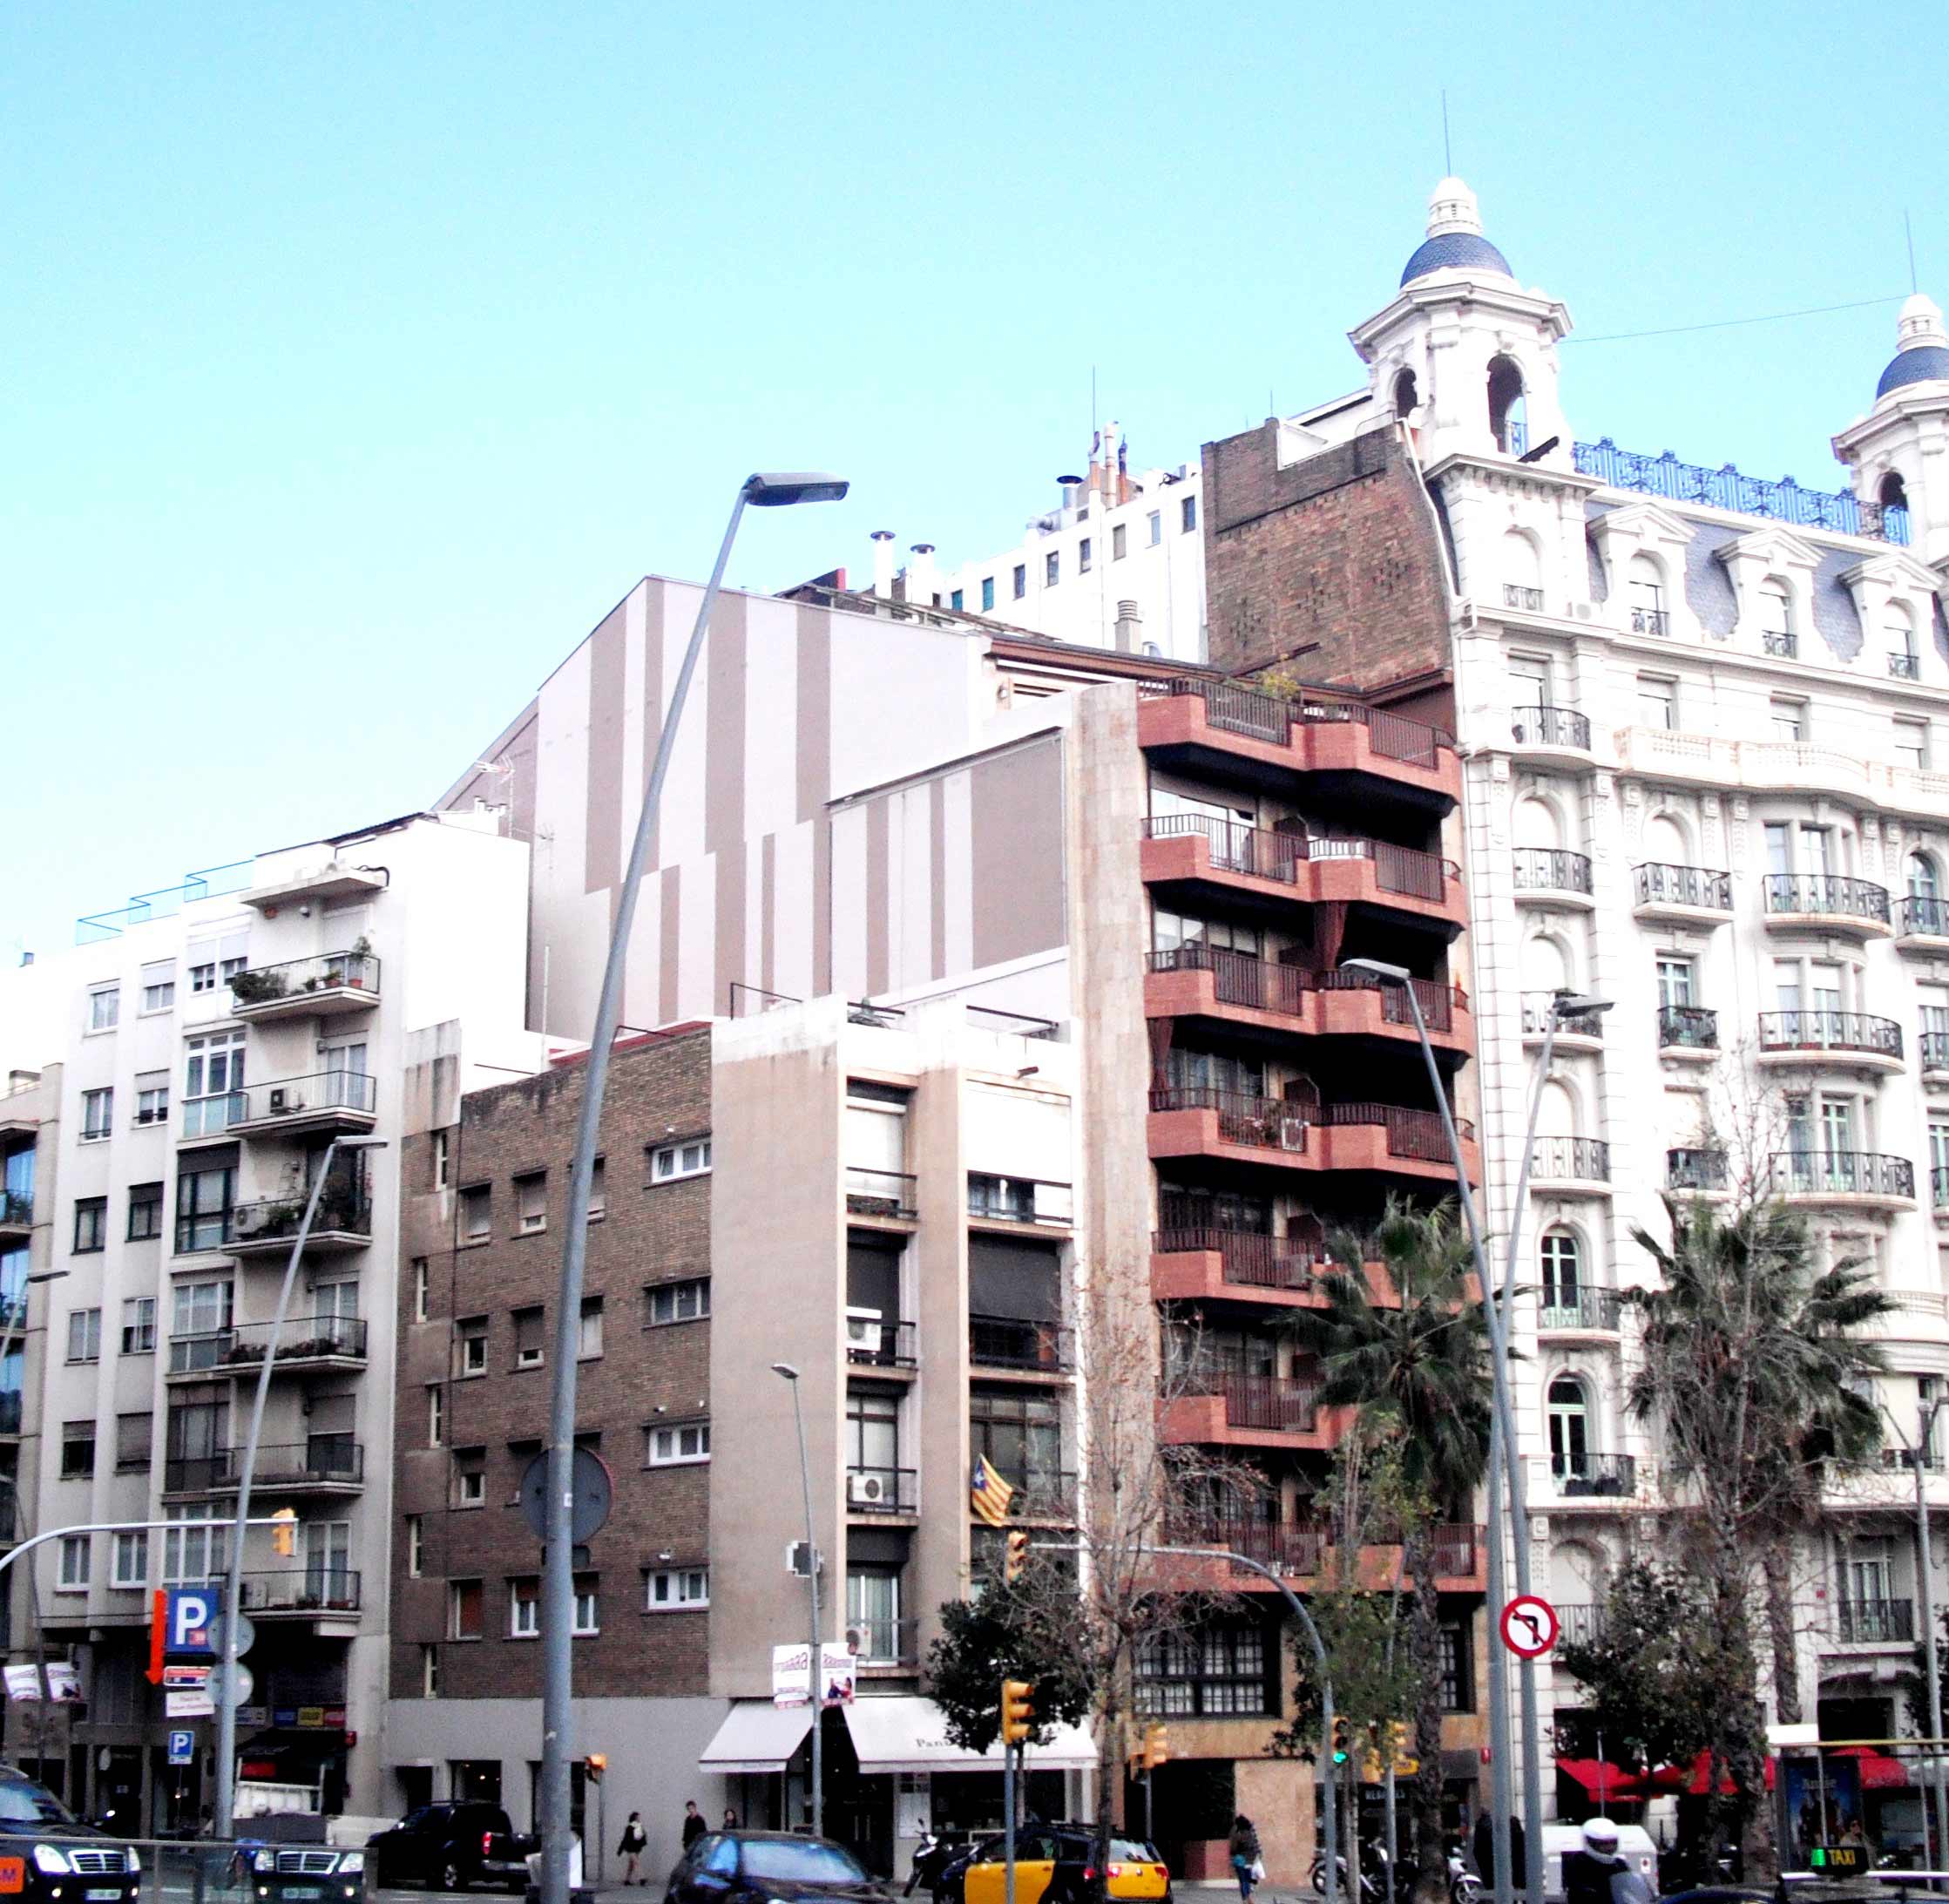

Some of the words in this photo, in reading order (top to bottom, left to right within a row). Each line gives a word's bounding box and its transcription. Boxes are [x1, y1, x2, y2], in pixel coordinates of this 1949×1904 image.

[175, 1596, 207, 1645] P
[173, 1733, 188, 1753] P
[1828, 1848, 1855, 1866] TAXI
